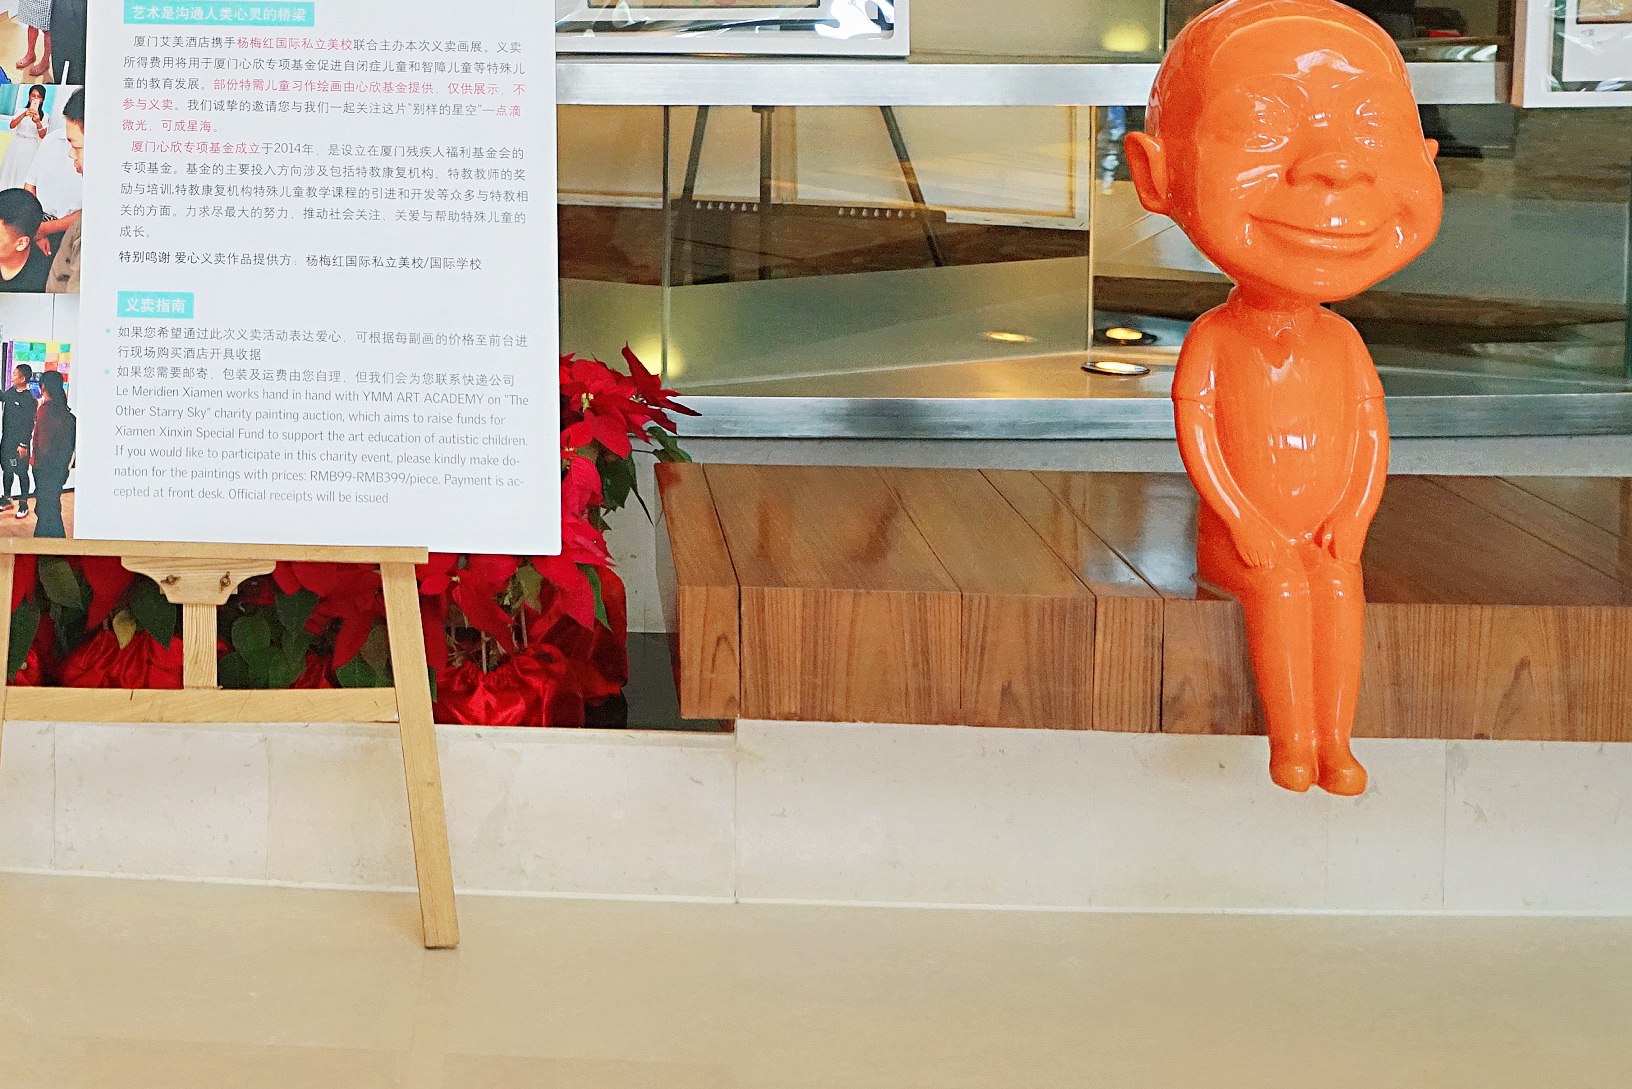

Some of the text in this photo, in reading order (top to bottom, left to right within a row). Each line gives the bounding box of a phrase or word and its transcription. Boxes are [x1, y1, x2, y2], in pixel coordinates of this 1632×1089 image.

[131, 5, 307, 23] 艺术是沟通人类心灵的桥梁
[133, 34, 523, 55] 厦门艾美酒店携手杨梅红国际私立美校联合主办本次义卖画展。义卖
[123, 55, 526, 76] 所得费用将用于厦门心欣专项基金促进自闭症儿童和智障儿童等特殊儿
[119, 224, 152, 240] 成长。
[119, 249, 171, 265] 特别鸣谢
[126, 297, 185, 314] 义卖指南
[117, 346, 261, 361] 行现场购买酒店开具收据
[116, 385, 129, 396] Le
[132, 386, 179, 397] Meridien
[183, 387, 223, 398] Xiamen
[227, 388, 259, 399] works
[263, 388, 288, 400] hand
[292, 389, 302, 400] in
[305, 389, 331, 401] hand
[335, 391, 359, 401] with
[363, 391, 393, 402] YMM
[396, 392, 420, 403] ART
[424, 393, 484, 405] ACADEMY
[487, 396, 501, 405] on
[115, 405, 144, 417] Other
[149, 406, 183, 420] Starry
[214, 408, 251, 421] charity
[255, 409, 299, 422] painting
[349, 411, 381, 422] which
[384, 412, 409, 423] aims
[413, 413, 424, 423] to
[427, 413, 453, 424] raise
[457, 413, 486, 425] funds
[490, 414, 506, 425] for
[115, 426, 528, 446] Xiamen Xinxin Special Fund to support the art education of autistic children.
[115, 445, 124, 456] If
[127, 448, 146, 459] you
[150, 447, 182, 457] would
[185, 447, 204, 458] like
[207, 448, 218, 459] to
[222, 448, 280, 461] participate
[284, 450, 293, 460] in
[297, 450, 316, 461] this
[320, 451, 357, 464] charity
[396, 453, 431, 465] please
[434, 454, 466, 467] kindly
[470, 455, 499, 466] make
[502, 455, 520, 466] do-
[114, 467, 148, 477] nation
[151, 467, 167, 478] for
[170, 467, 188, 478] the
[191, 468, 241, 481] paintings
[244, 469, 268, 480] with
[272, 471, 307, 482] prices:
[444, 474, 492, 487] Payment
[495, 474, 504, 486] is
[507, 476, 524, 487] ac-
[114, 486, 389, 503] cepted at front desk. Official receipts will be issued
